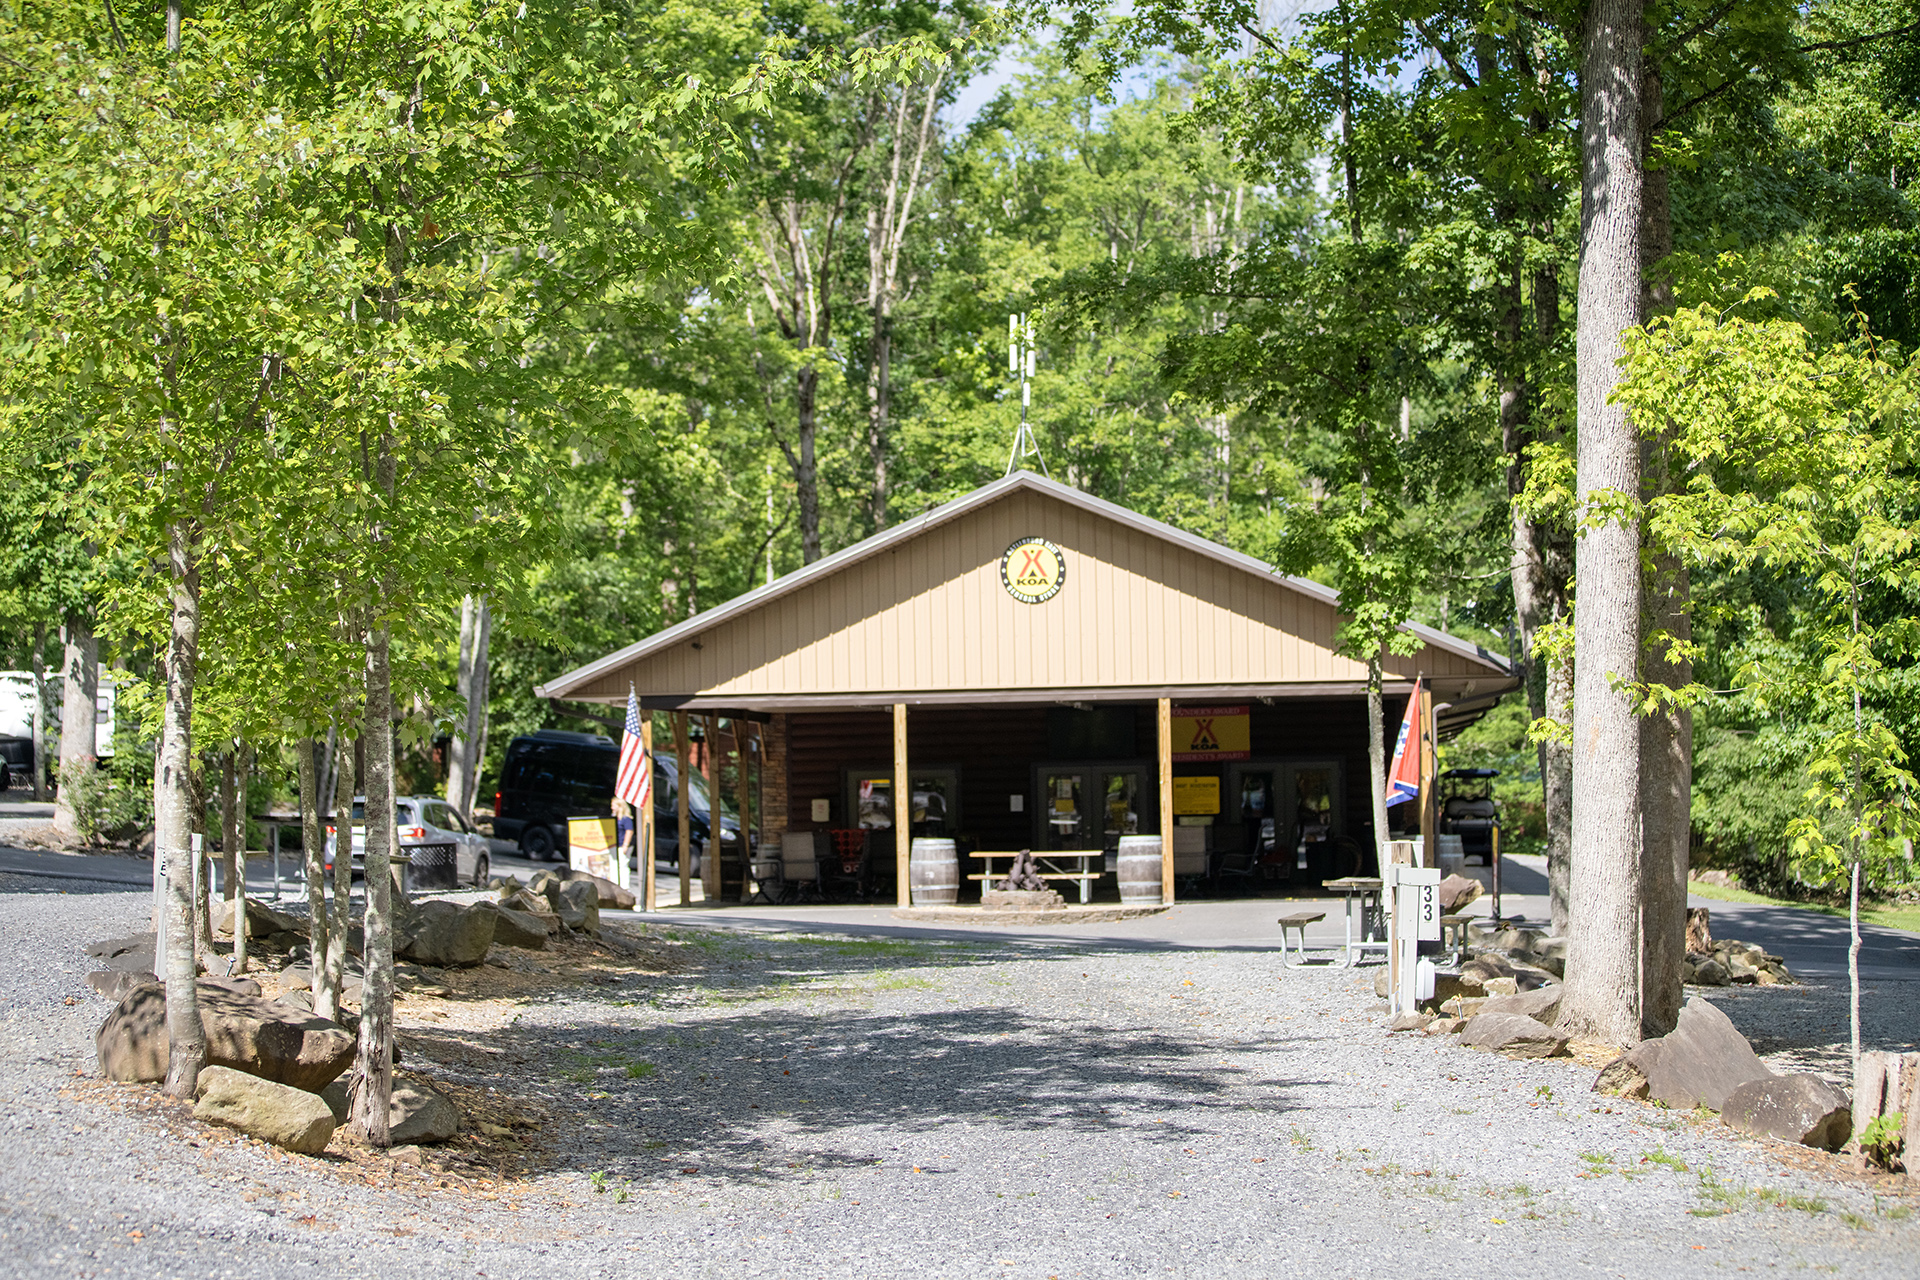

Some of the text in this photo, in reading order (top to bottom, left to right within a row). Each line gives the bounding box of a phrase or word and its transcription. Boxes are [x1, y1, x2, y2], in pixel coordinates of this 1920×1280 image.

[1016, 578, 1049, 586] KOA
[1172, 707, 1240, 716] OUNDER'S AWARD
[1172, 752, 1244, 761] RESIDENT'S AWARD
[1423, 885, 1433, 921] 33
